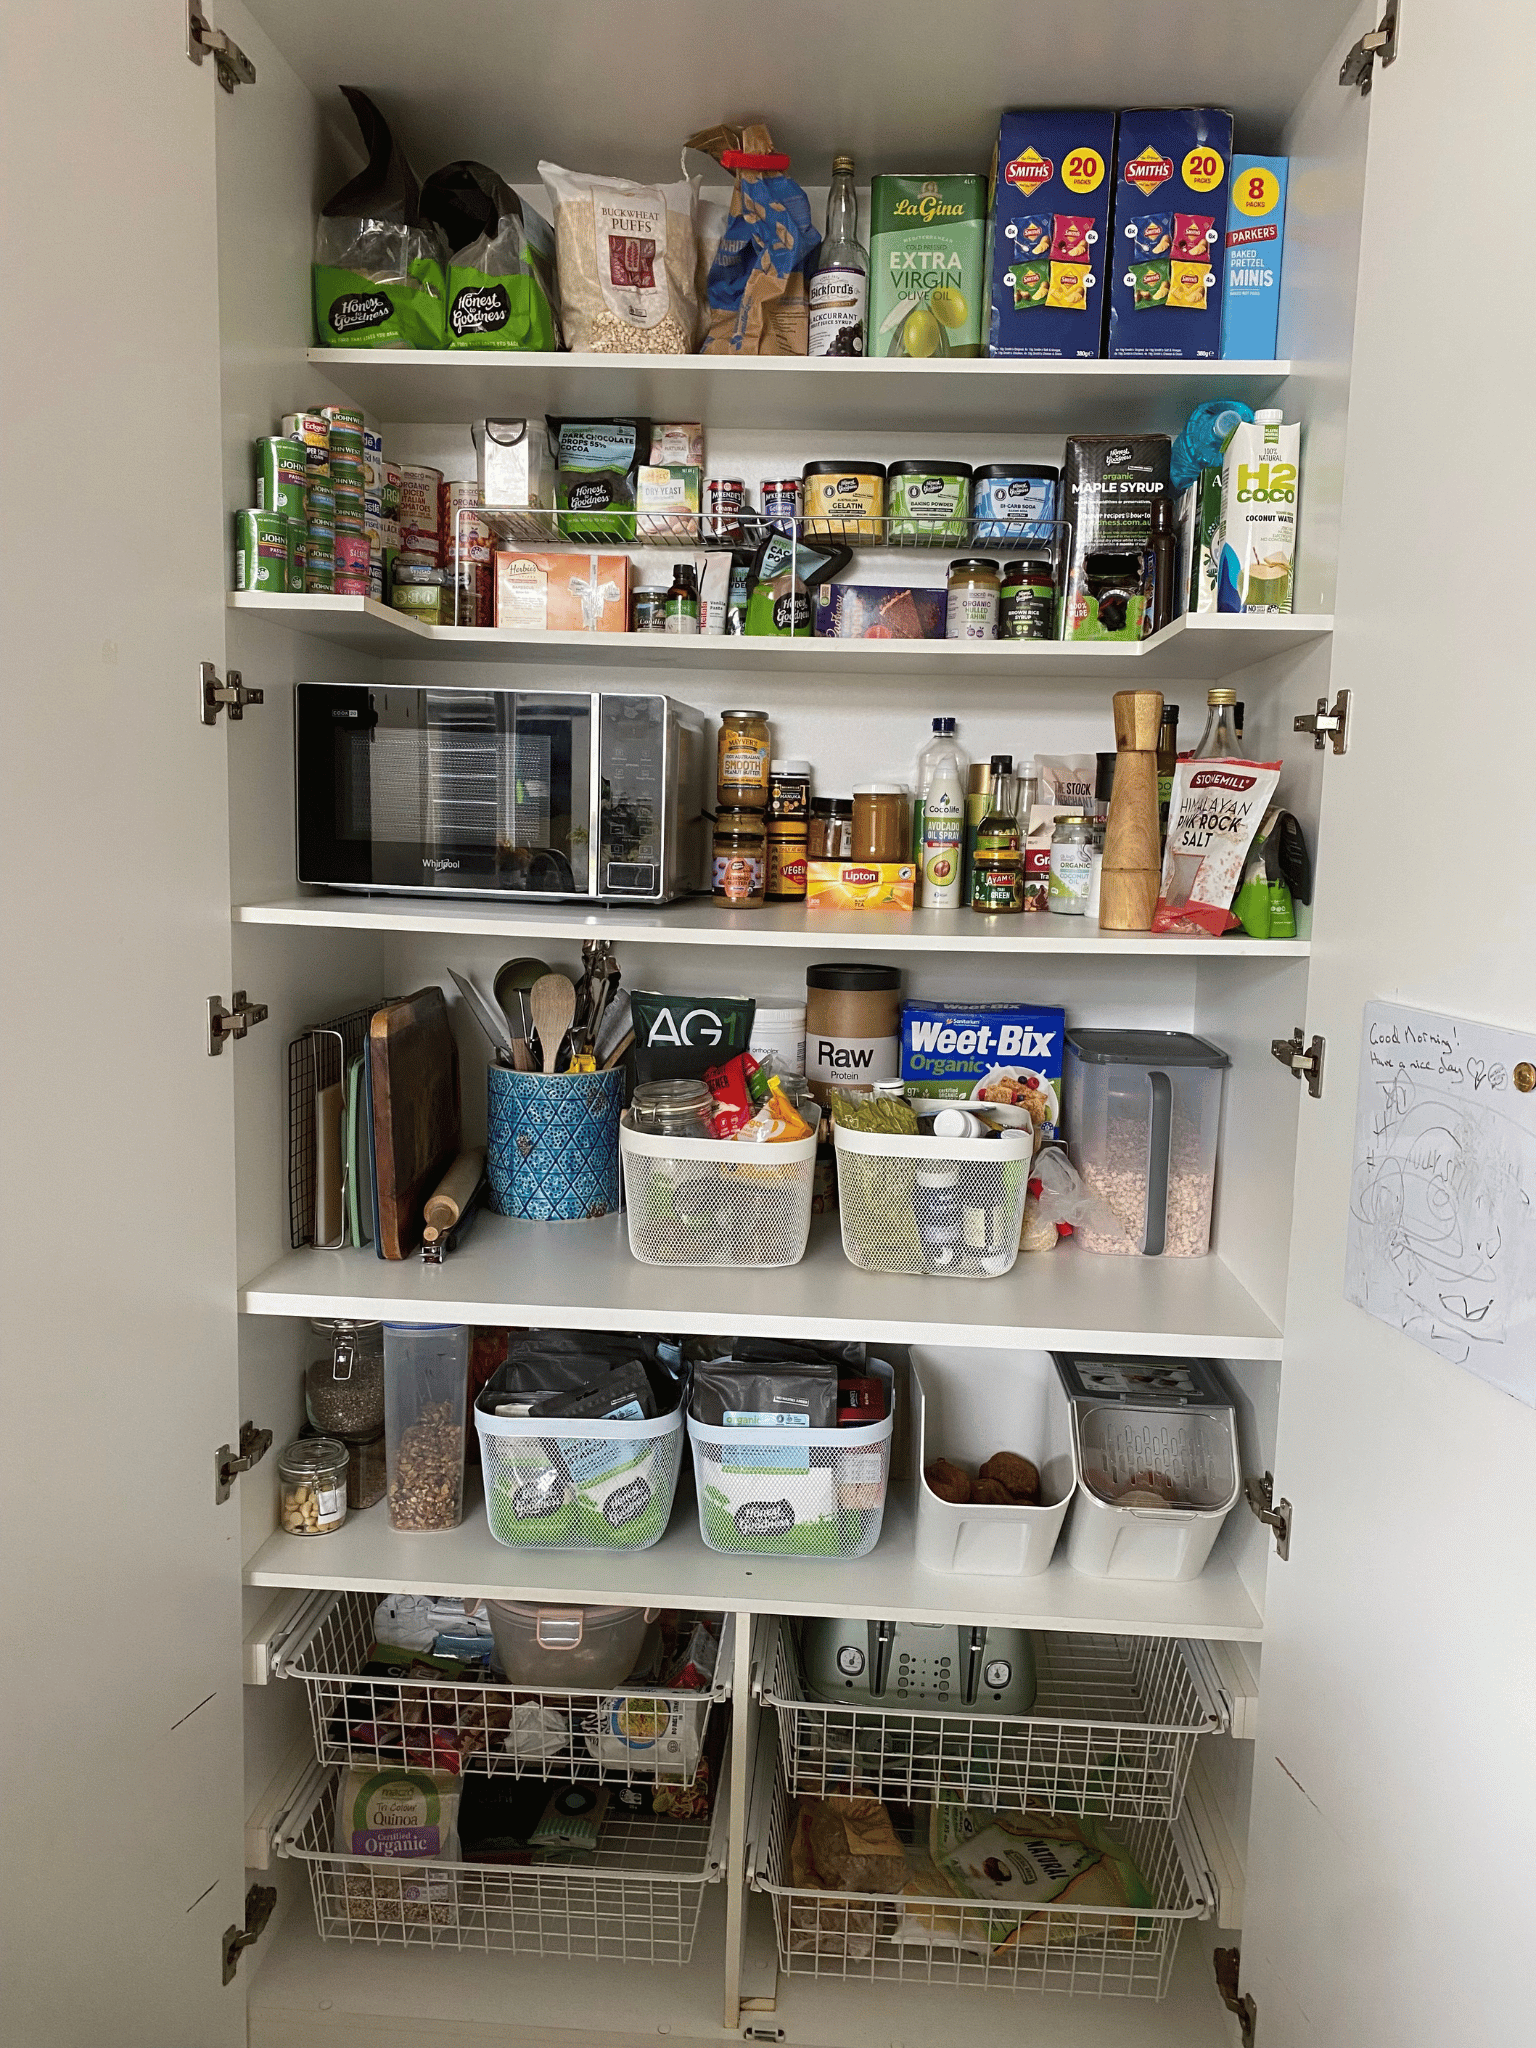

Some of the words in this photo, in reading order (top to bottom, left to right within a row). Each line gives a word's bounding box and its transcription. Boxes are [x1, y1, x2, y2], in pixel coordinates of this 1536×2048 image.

[1007, 163, 1050, 177] SMITH'S
[1069, 157, 1097, 178] 20
[1127, 162, 1170, 177] SMITH'S
[1190, 156, 1216, 176] 20
[1248, 178, 1264, 199] 8
[602, 207, 660, 221] BUCKWHEAT
[611, 218, 652, 233] PUFFS
[890, 251, 962, 269] EXTRA
[1231, 250, 1256, 259] BAKED
[1231, 259, 1265, 267] PRETZEL
[890, 271, 962, 289] VIRGIN
[1229, 269, 1274, 287] MINIS
[459, 293, 501, 310] Honest
[898, 291, 929, 301] OLIVE
[933, 291, 952, 301] OIL
[342, 298, 383, 315] Honest
[335, 307, 389, 330] Goodness
[453, 310, 505, 333] Goodness
[585, 434, 634, 445] CHOCOLATE
[590, 441, 607, 449] 55%
[561, 445, 589, 453] COCOA
[281, 460, 305, 472] JOHN
[334, 477, 348, 485] OHN
[1103, 472, 1133, 481] organic
[1237, 463, 1297, 491] H2
[313, 486, 331, 494] JOHN
[403, 489, 424, 498] DICED
[576, 485, 607, 497] Honest
[645, 487, 660, 496] DRY
[661, 487, 681, 496] YEAST
[1072, 482, 1117, 494] MAPLE
[1119, 482, 1164, 494] SYRUP
[400, 502, 431, 512] OMATOES
[570, 495, 610, 510] Goodness
[312, 518, 331, 526] JOHN
[311, 550, 330, 558] JOHN
[770, 546, 790, 557] CAC
[509, 563, 537, 575] Herbie's
[728, 739, 758, 747] MAYVER'S
[724, 760, 761, 771] SMOOTH
[1196, 774, 1246, 789] STONEMILL
[1066, 782, 1092, 796] STOCK
[929, 805, 960, 813] Cocolife
[1180, 797, 1253, 816] HIMALAYAN
[927, 821, 960, 831] AVOCADO
[1199, 814, 1243, 832] ROCK
[927, 831, 938, 840] OIL
[939, 831, 960, 840] SPRAY
[1182, 831, 1214, 847] SALT
[422, 859, 460, 871] Whirlpool
[845, 871, 876, 882] Lipton
[985, 875, 1008, 887] AYAM
[647, 1008, 737, 1048] AG1
[1370, 1022, 1400, 1045] Good
[911, 1021, 1056, 1057] Weet-Bix
[752, 1047, 779, 1055] orthoplex
[818, 1041, 874, 1068] Raw
[910, 1054, 984, 1075] Organic
[1370, 1050, 1394, 1068] Have
[1410, 1060, 1435, 1070] nice
[1439, 1056, 1464, 1083] day
[830, 1071, 859, 1080] Protein
[726, 1414, 760, 1425] organic
[376, 1802, 388, 1812] Tri
[390, 1802, 417, 1812] Colour
[373, 1812, 418, 1826] Quinoa
[377, 1832, 411, 1841] Certified
[365, 1835, 427, 1857] Organic
[1024, 1840, 1069, 1879] NATURAL
